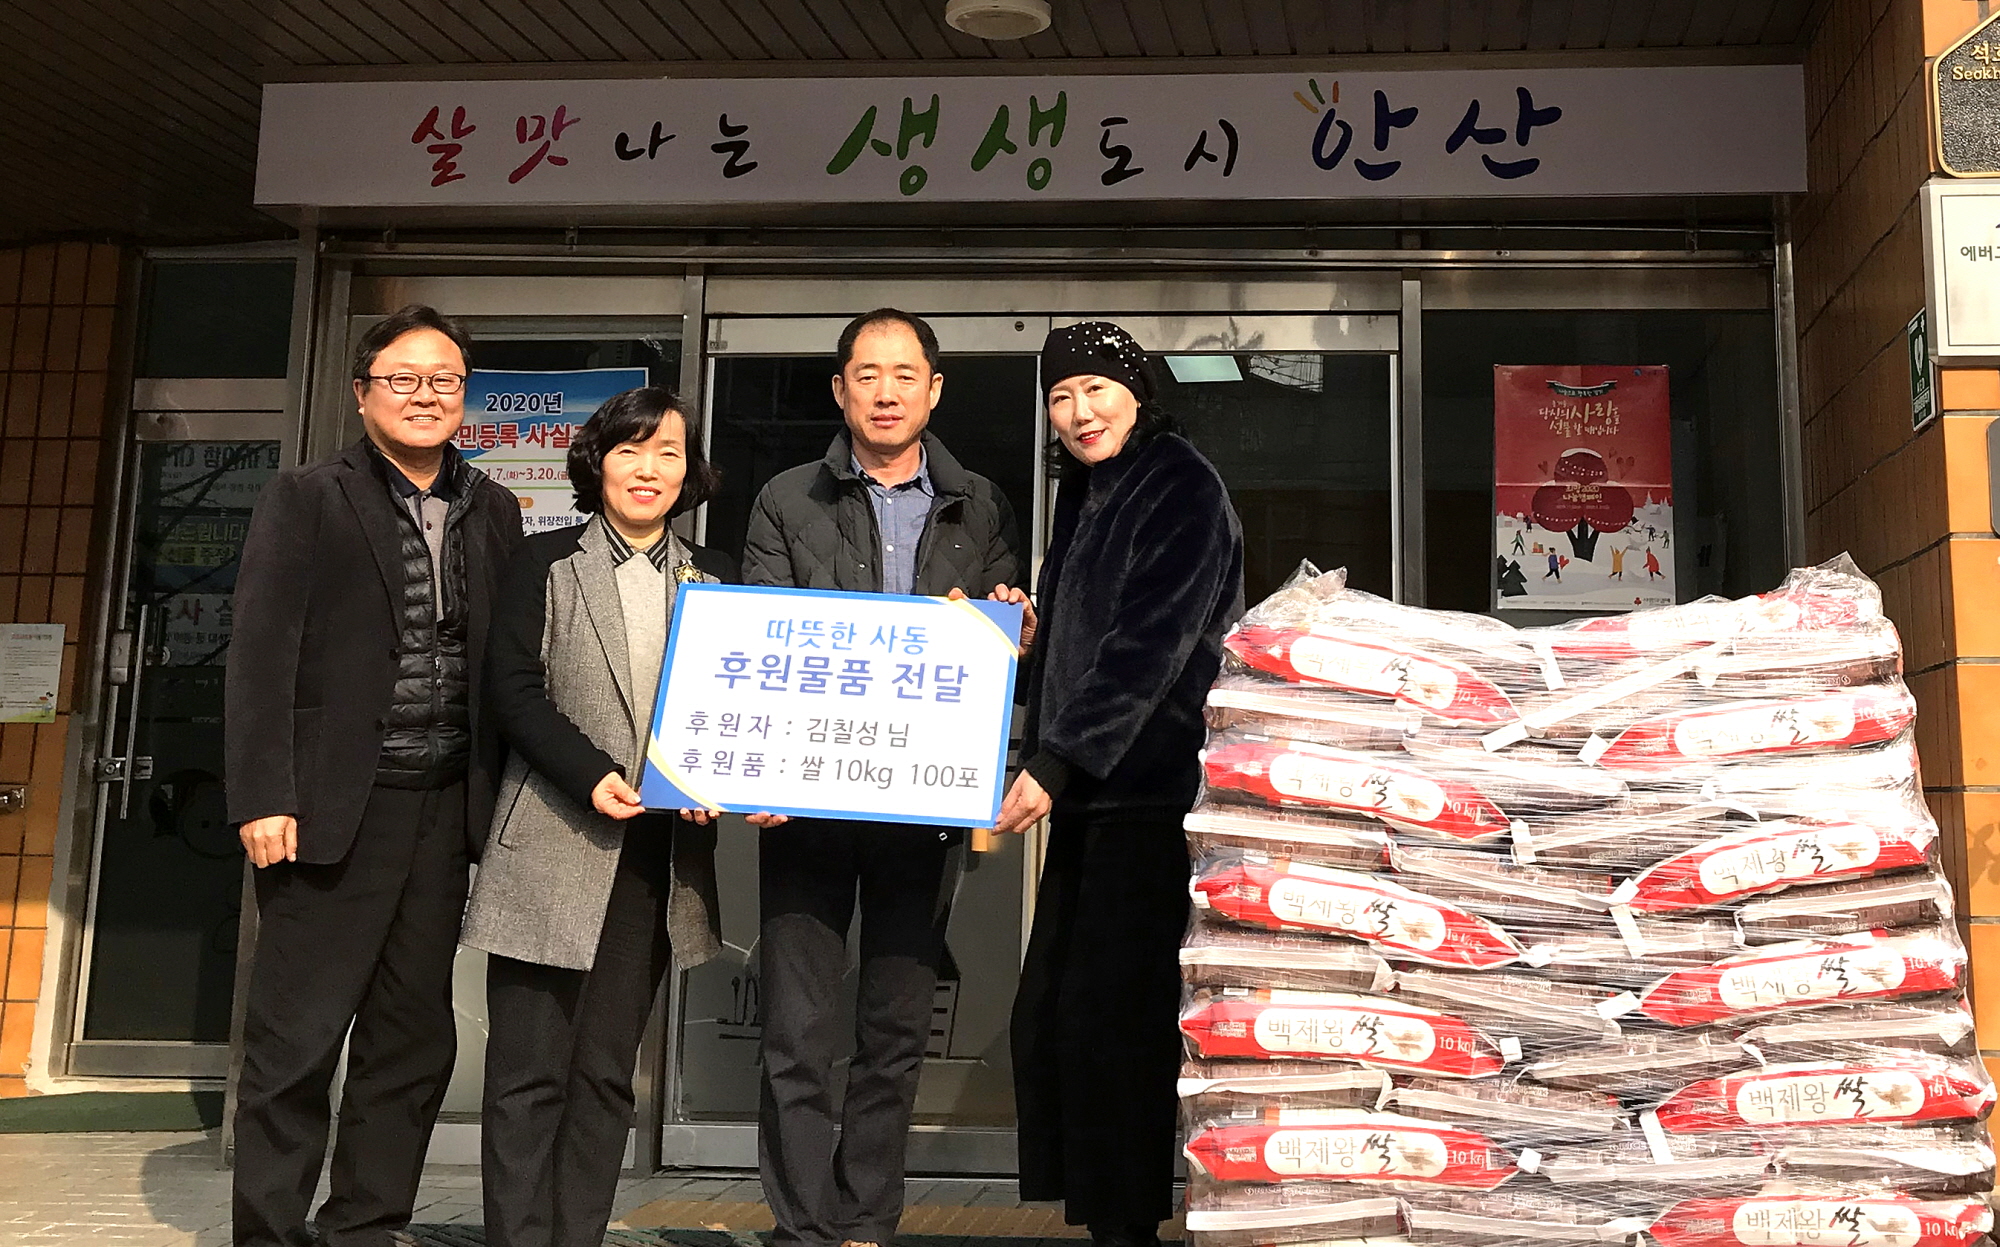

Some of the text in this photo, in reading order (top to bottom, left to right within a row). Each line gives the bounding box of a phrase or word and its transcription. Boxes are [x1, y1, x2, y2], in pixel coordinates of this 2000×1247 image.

[1312, 87, 1562, 181] 안산
[486, 392, 563, 415] 2020년
[525, 423, 583, 449] 사실
[538, 516, 573, 526] 위장전입
[766, 618, 929, 655] 따뜻한 사동
[714, 651, 969, 703] 후원물품 전달
[685, 711, 773, 739] 후원자
[806, 717, 879, 746] 김칠성
[889, 722, 910, 748] 님
[678, 748, 766, 778] 후원품
[800, 755, 825, 782] 쌀
[834, 759, 893, 790] 10kg
[911, 763, 980, 789] 100포
[1268, 1017, 1344, 1048] 백제왕
[1749, 1081, 1830, 1117] 백제왕
[1277, 1136, 1357, 1169] 백제왕
[1745, 1207, 1826, 1240] 백제왕
